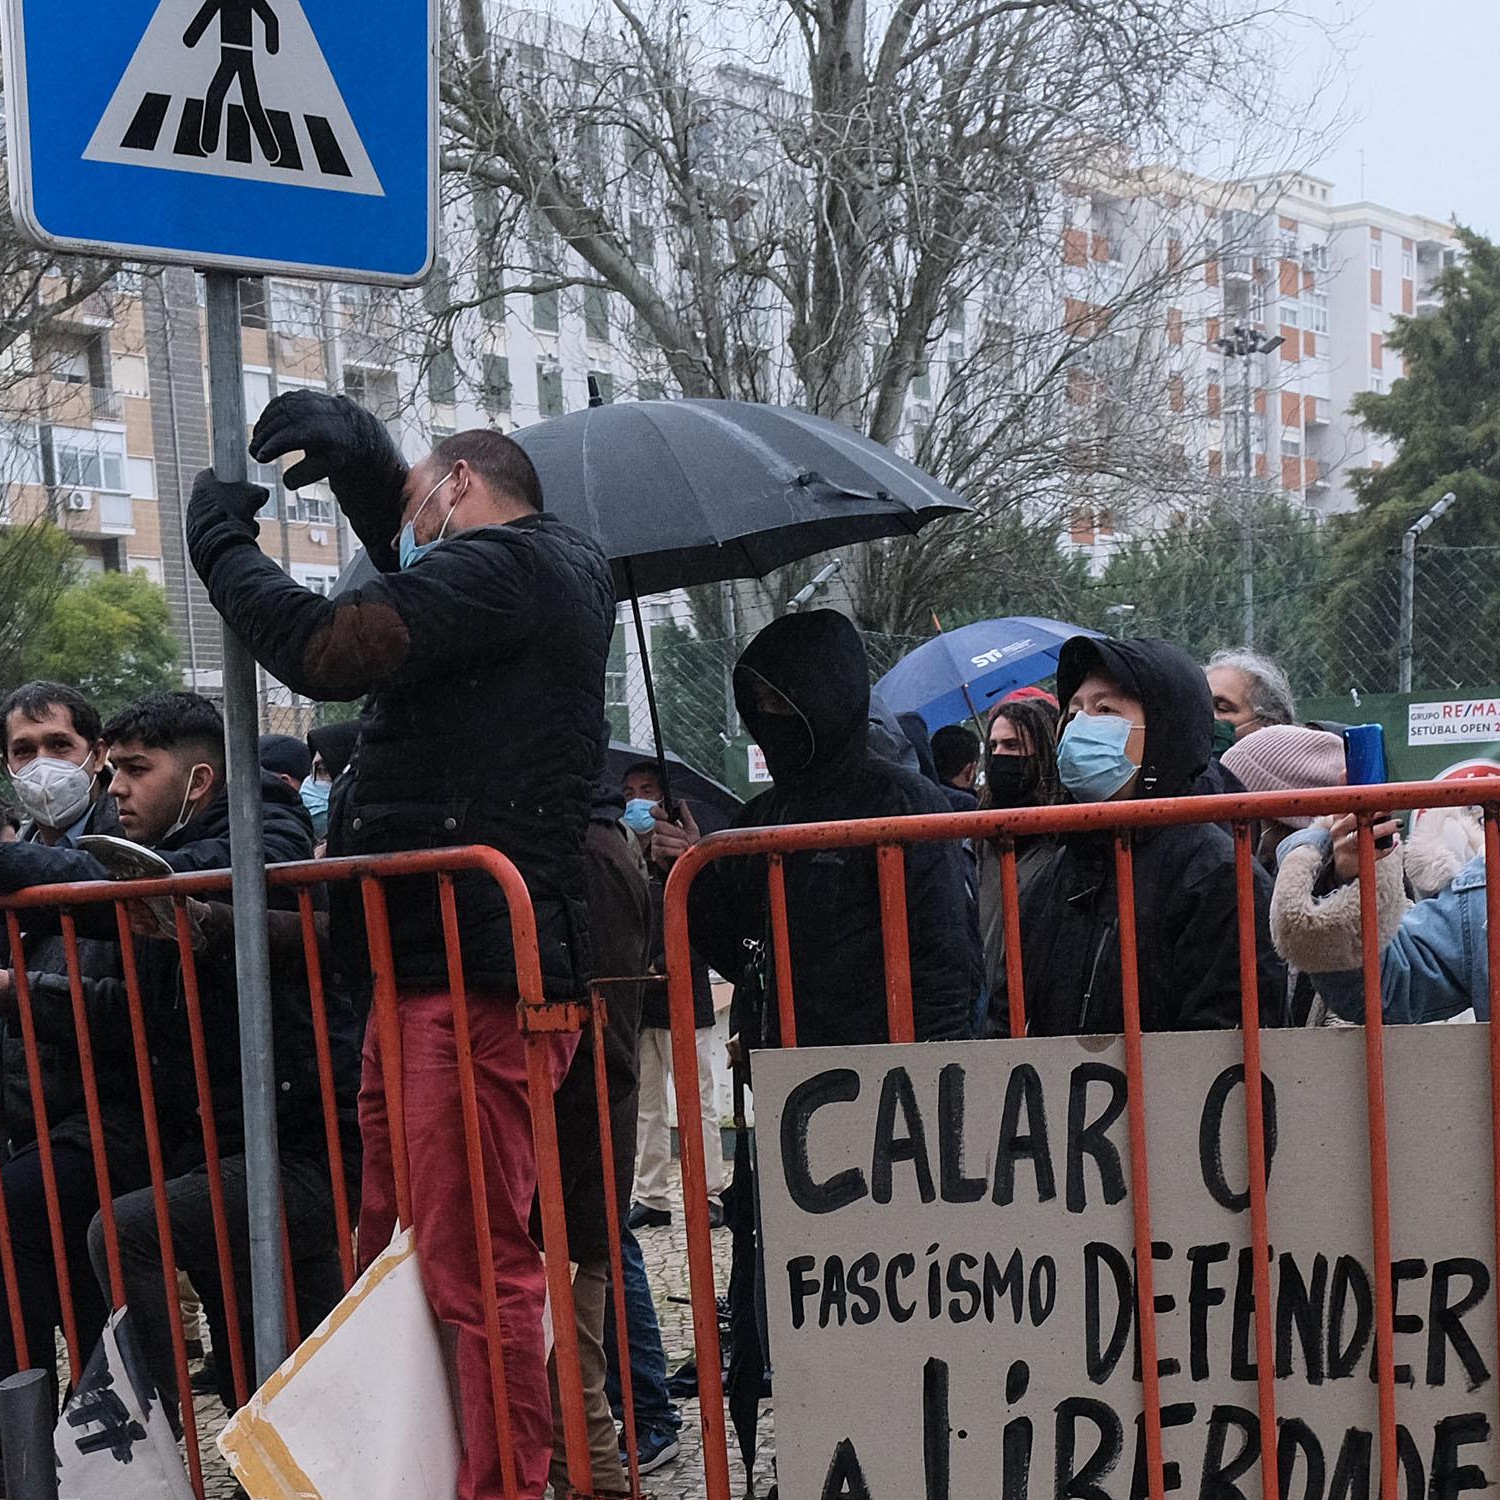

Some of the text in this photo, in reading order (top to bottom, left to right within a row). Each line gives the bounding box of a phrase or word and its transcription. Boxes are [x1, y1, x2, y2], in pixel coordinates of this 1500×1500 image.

[1410, 711, 1440, 721] GRUPO
[1410, 721, 1457, 736] SETÚBAL
[1460, 722, 1491, 733] OPEN
[779, 1062, 1278, 1215] CALAR O
[1083, 1240, 1492, 1392] DEFENDER
